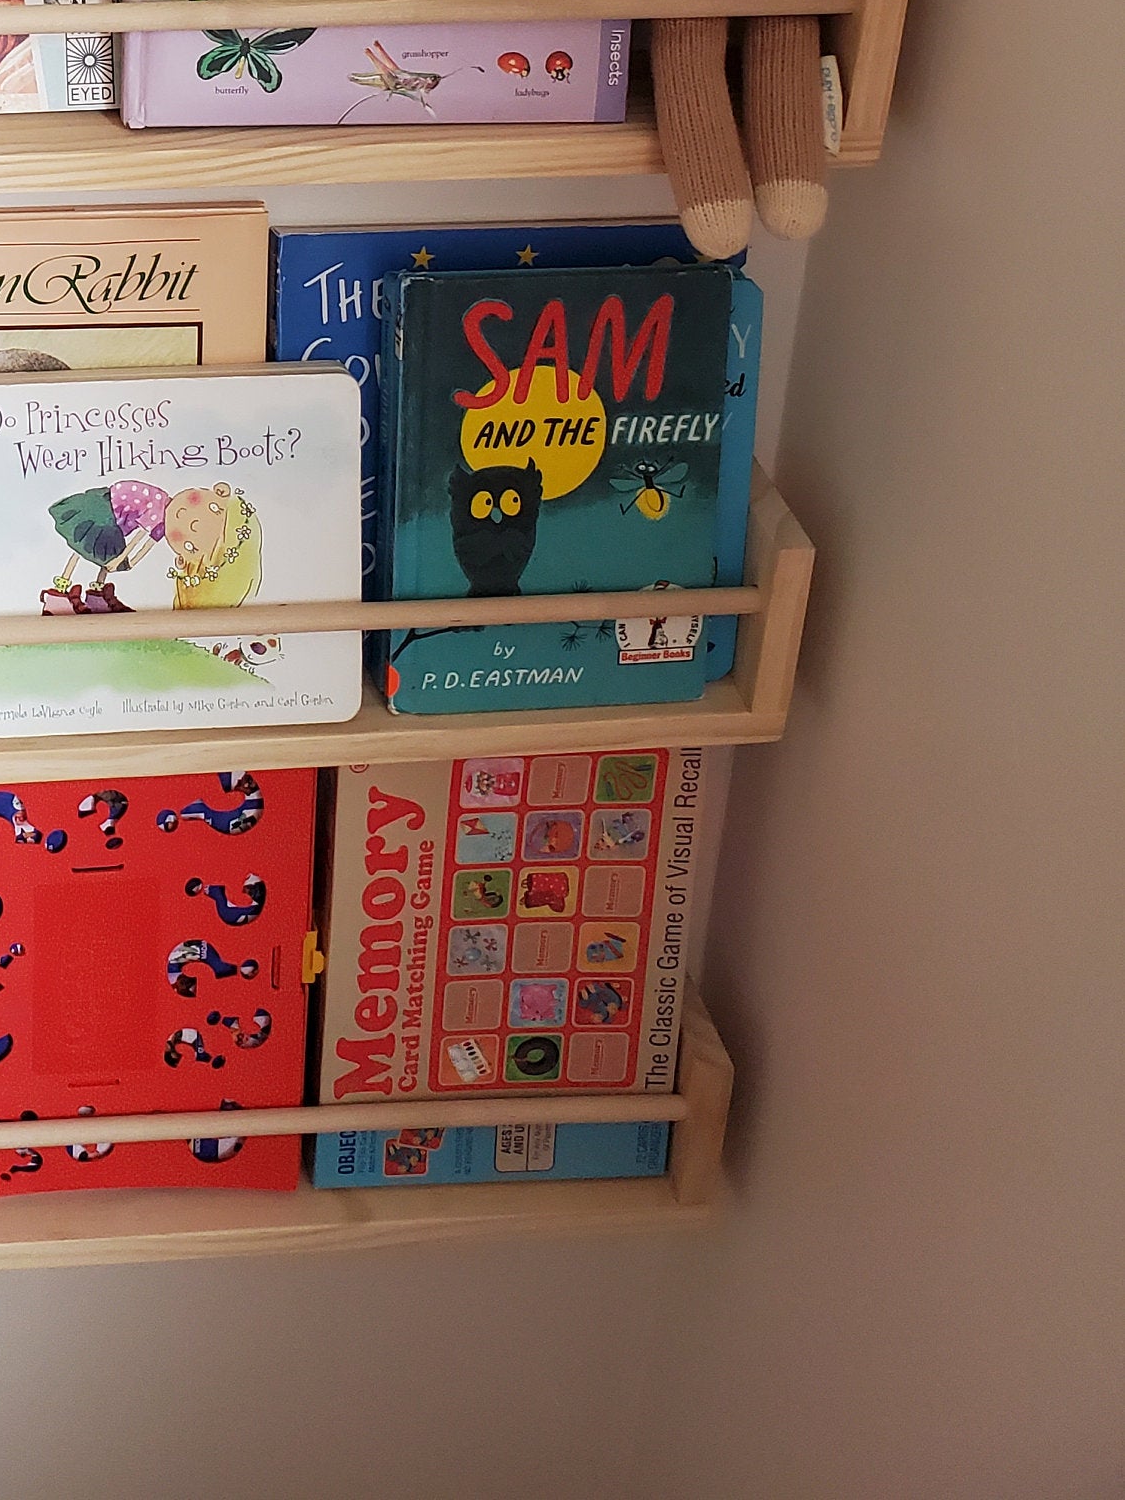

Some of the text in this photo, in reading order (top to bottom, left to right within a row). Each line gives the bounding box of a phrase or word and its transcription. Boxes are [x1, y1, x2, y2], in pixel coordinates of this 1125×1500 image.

[401, 49, 449, 60] grasshopper
[607, 28, 623, 86] Insects
[71, 88, 111, 104] EYED
[215, 86, 249, 96] butterfly
[515, 88, 550, 98] ladybugs
[453, 293, 673, 410] SAM
[25, 399, 171, 438] Princesses
[474, 413, 720, 450] AND THE FIREFLY
[14, 426, 303, 480] Wear Hiking Boots?
[621, 650, 691, 662] Beginner Books
[645, 747, 702, 1090] The Classic Game of Visual Recall
[333, 785, 425, 1100] Memory
[398, 840, 435, 1092] Card Matching Game
